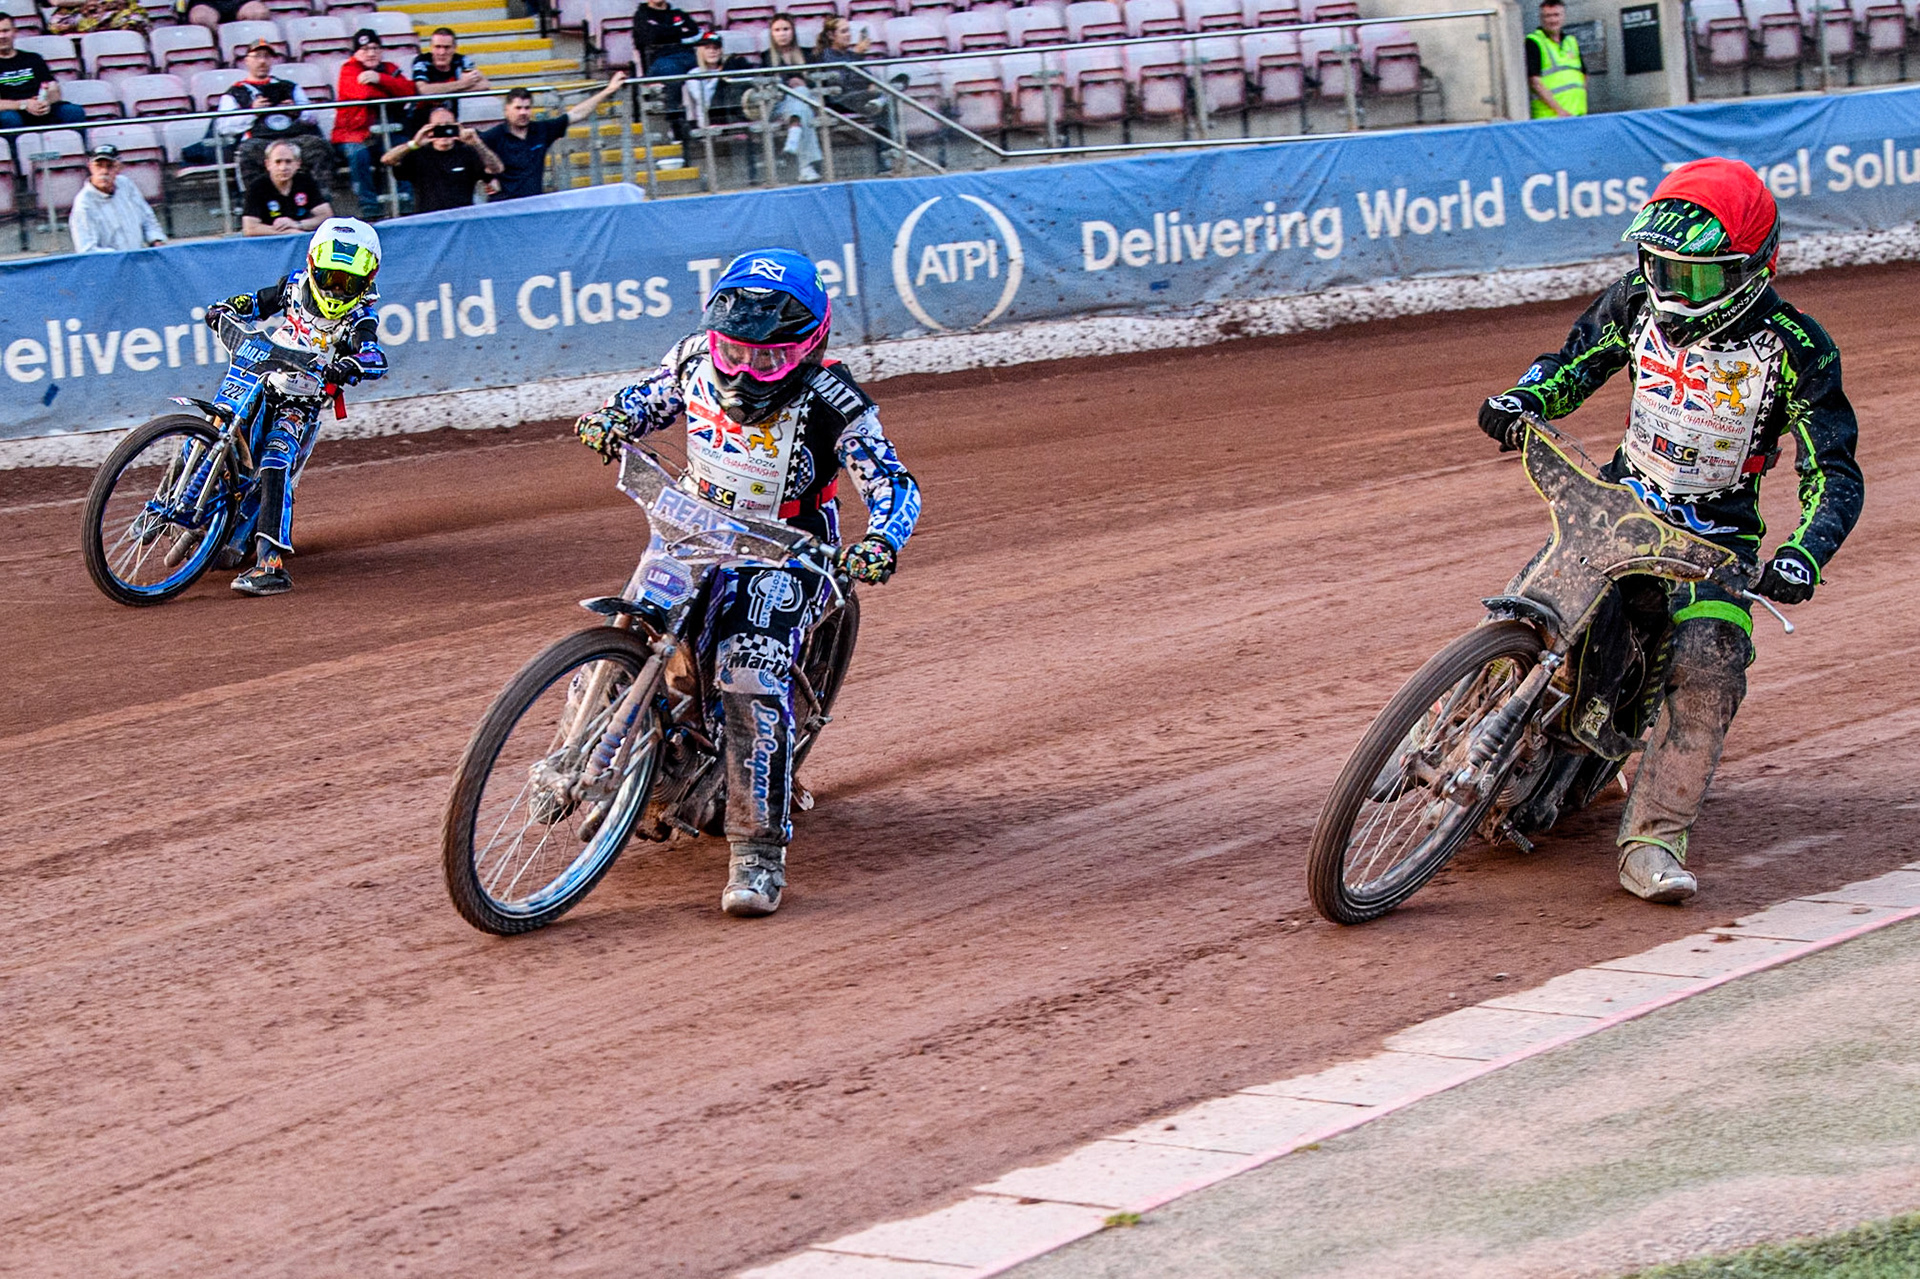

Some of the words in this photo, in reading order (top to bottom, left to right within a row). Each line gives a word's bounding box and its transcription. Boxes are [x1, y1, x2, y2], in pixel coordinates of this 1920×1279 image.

[1081, 201, 1344, 271] Delivering
[1357, 177, 1506, 240] World
[1521, 170, 1650, 223] Class
[914, 239, 999, 287] ATPI
[376, 278, 497, 346] orld
[516, 270, 672, 330] Class
[687, 244, 859, 312] Tel
[1755, 332, 1778, 353] 44
[1772, 312, 1816, 349] VICKY
[236, 338, 271, 363] BAILEY
[813, 370, 868, 415] MATT
[1658, 403, 1683, 418] YOUTH
[1683, 414, 1746, 435] CHAMPIONSHIP
[748, 456, 776, 469] 2024
[1655, 436, 1696, 461] NSSC
[723, 457, 780, 478] CHAMPIONSHIP
[699, 478, 734, 505] NSSC
[775, 576, 789, 608] ASSIST
